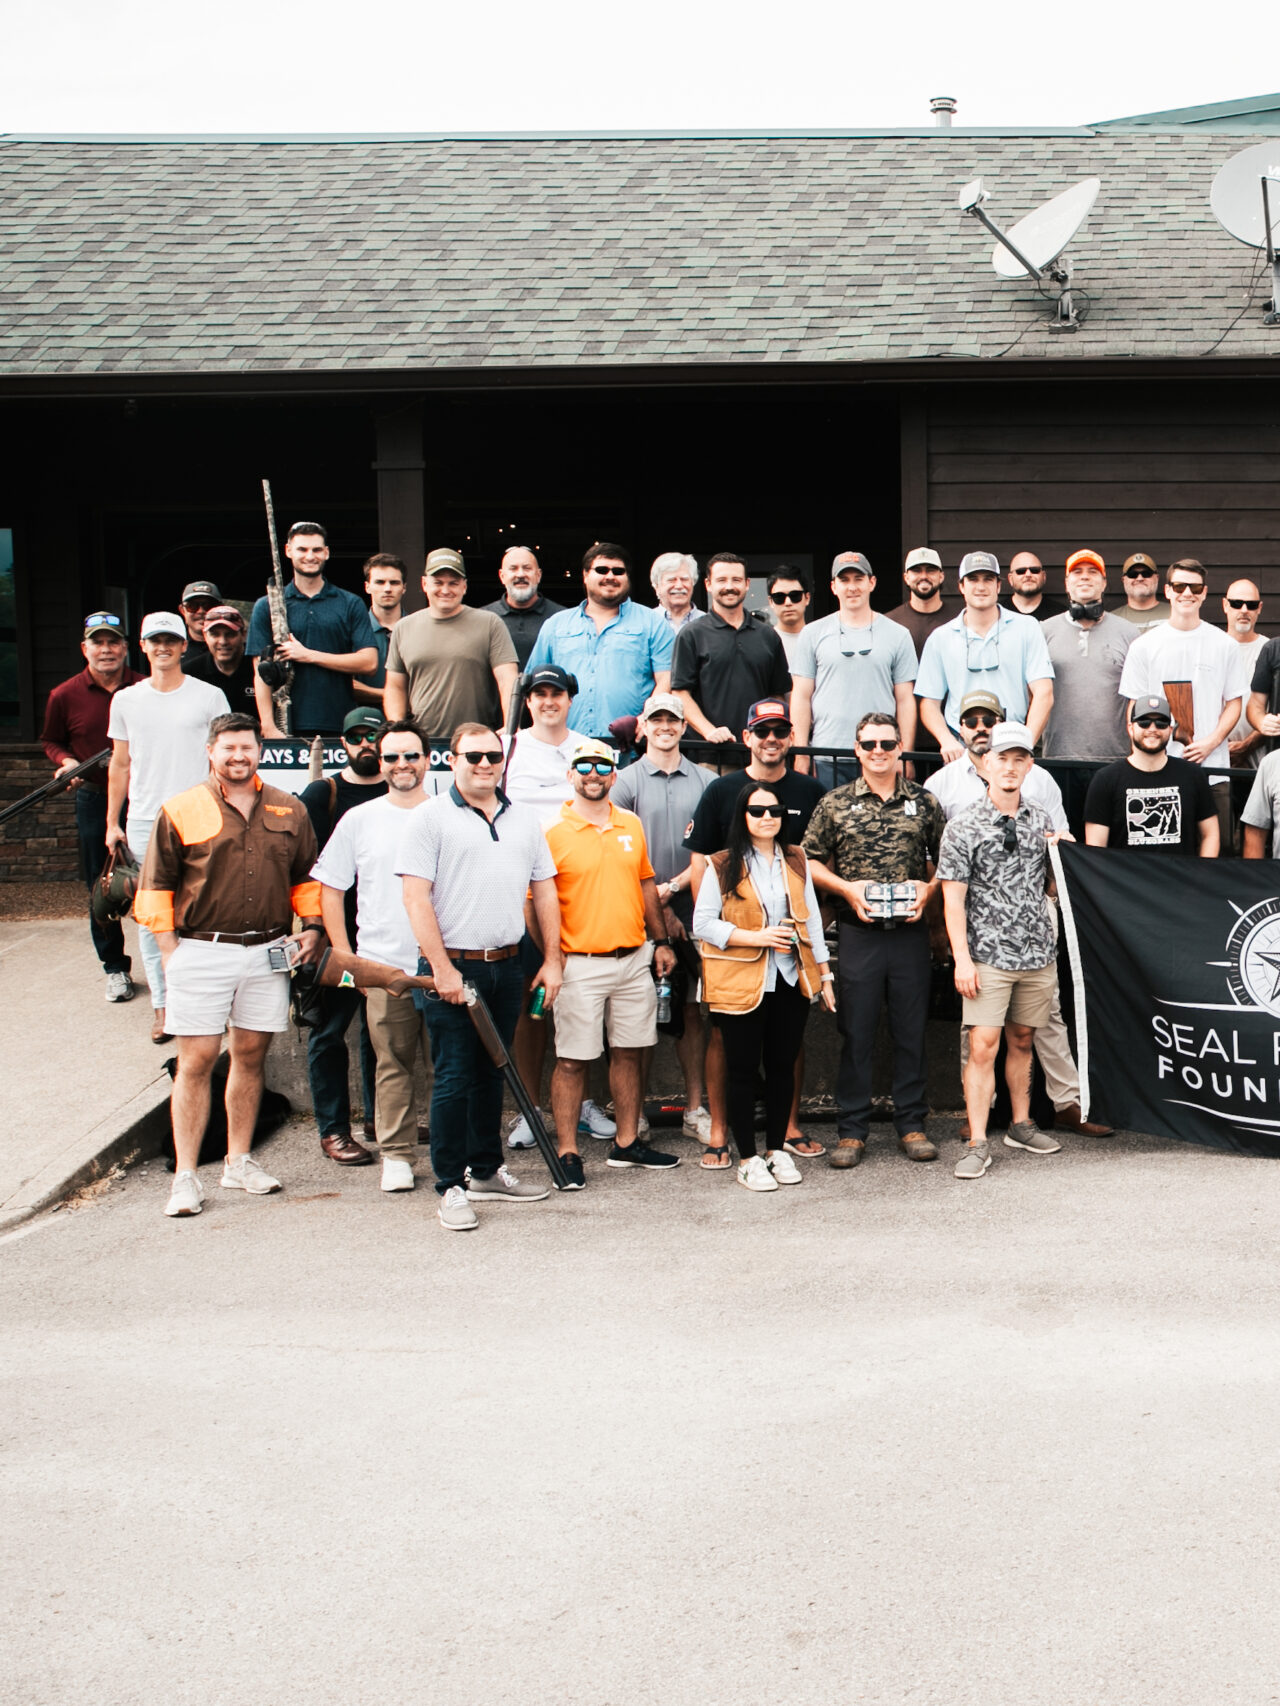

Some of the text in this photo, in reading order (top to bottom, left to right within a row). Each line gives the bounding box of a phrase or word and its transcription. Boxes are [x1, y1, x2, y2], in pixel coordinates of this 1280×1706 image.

[259, 748, 294, 764] AYS
[322, 748, 348, 764] CIG
[904, 799, 917, 816] N
[617, 834, 633, 851] T
[1151, 1014, 1257, 1066] SEAL
